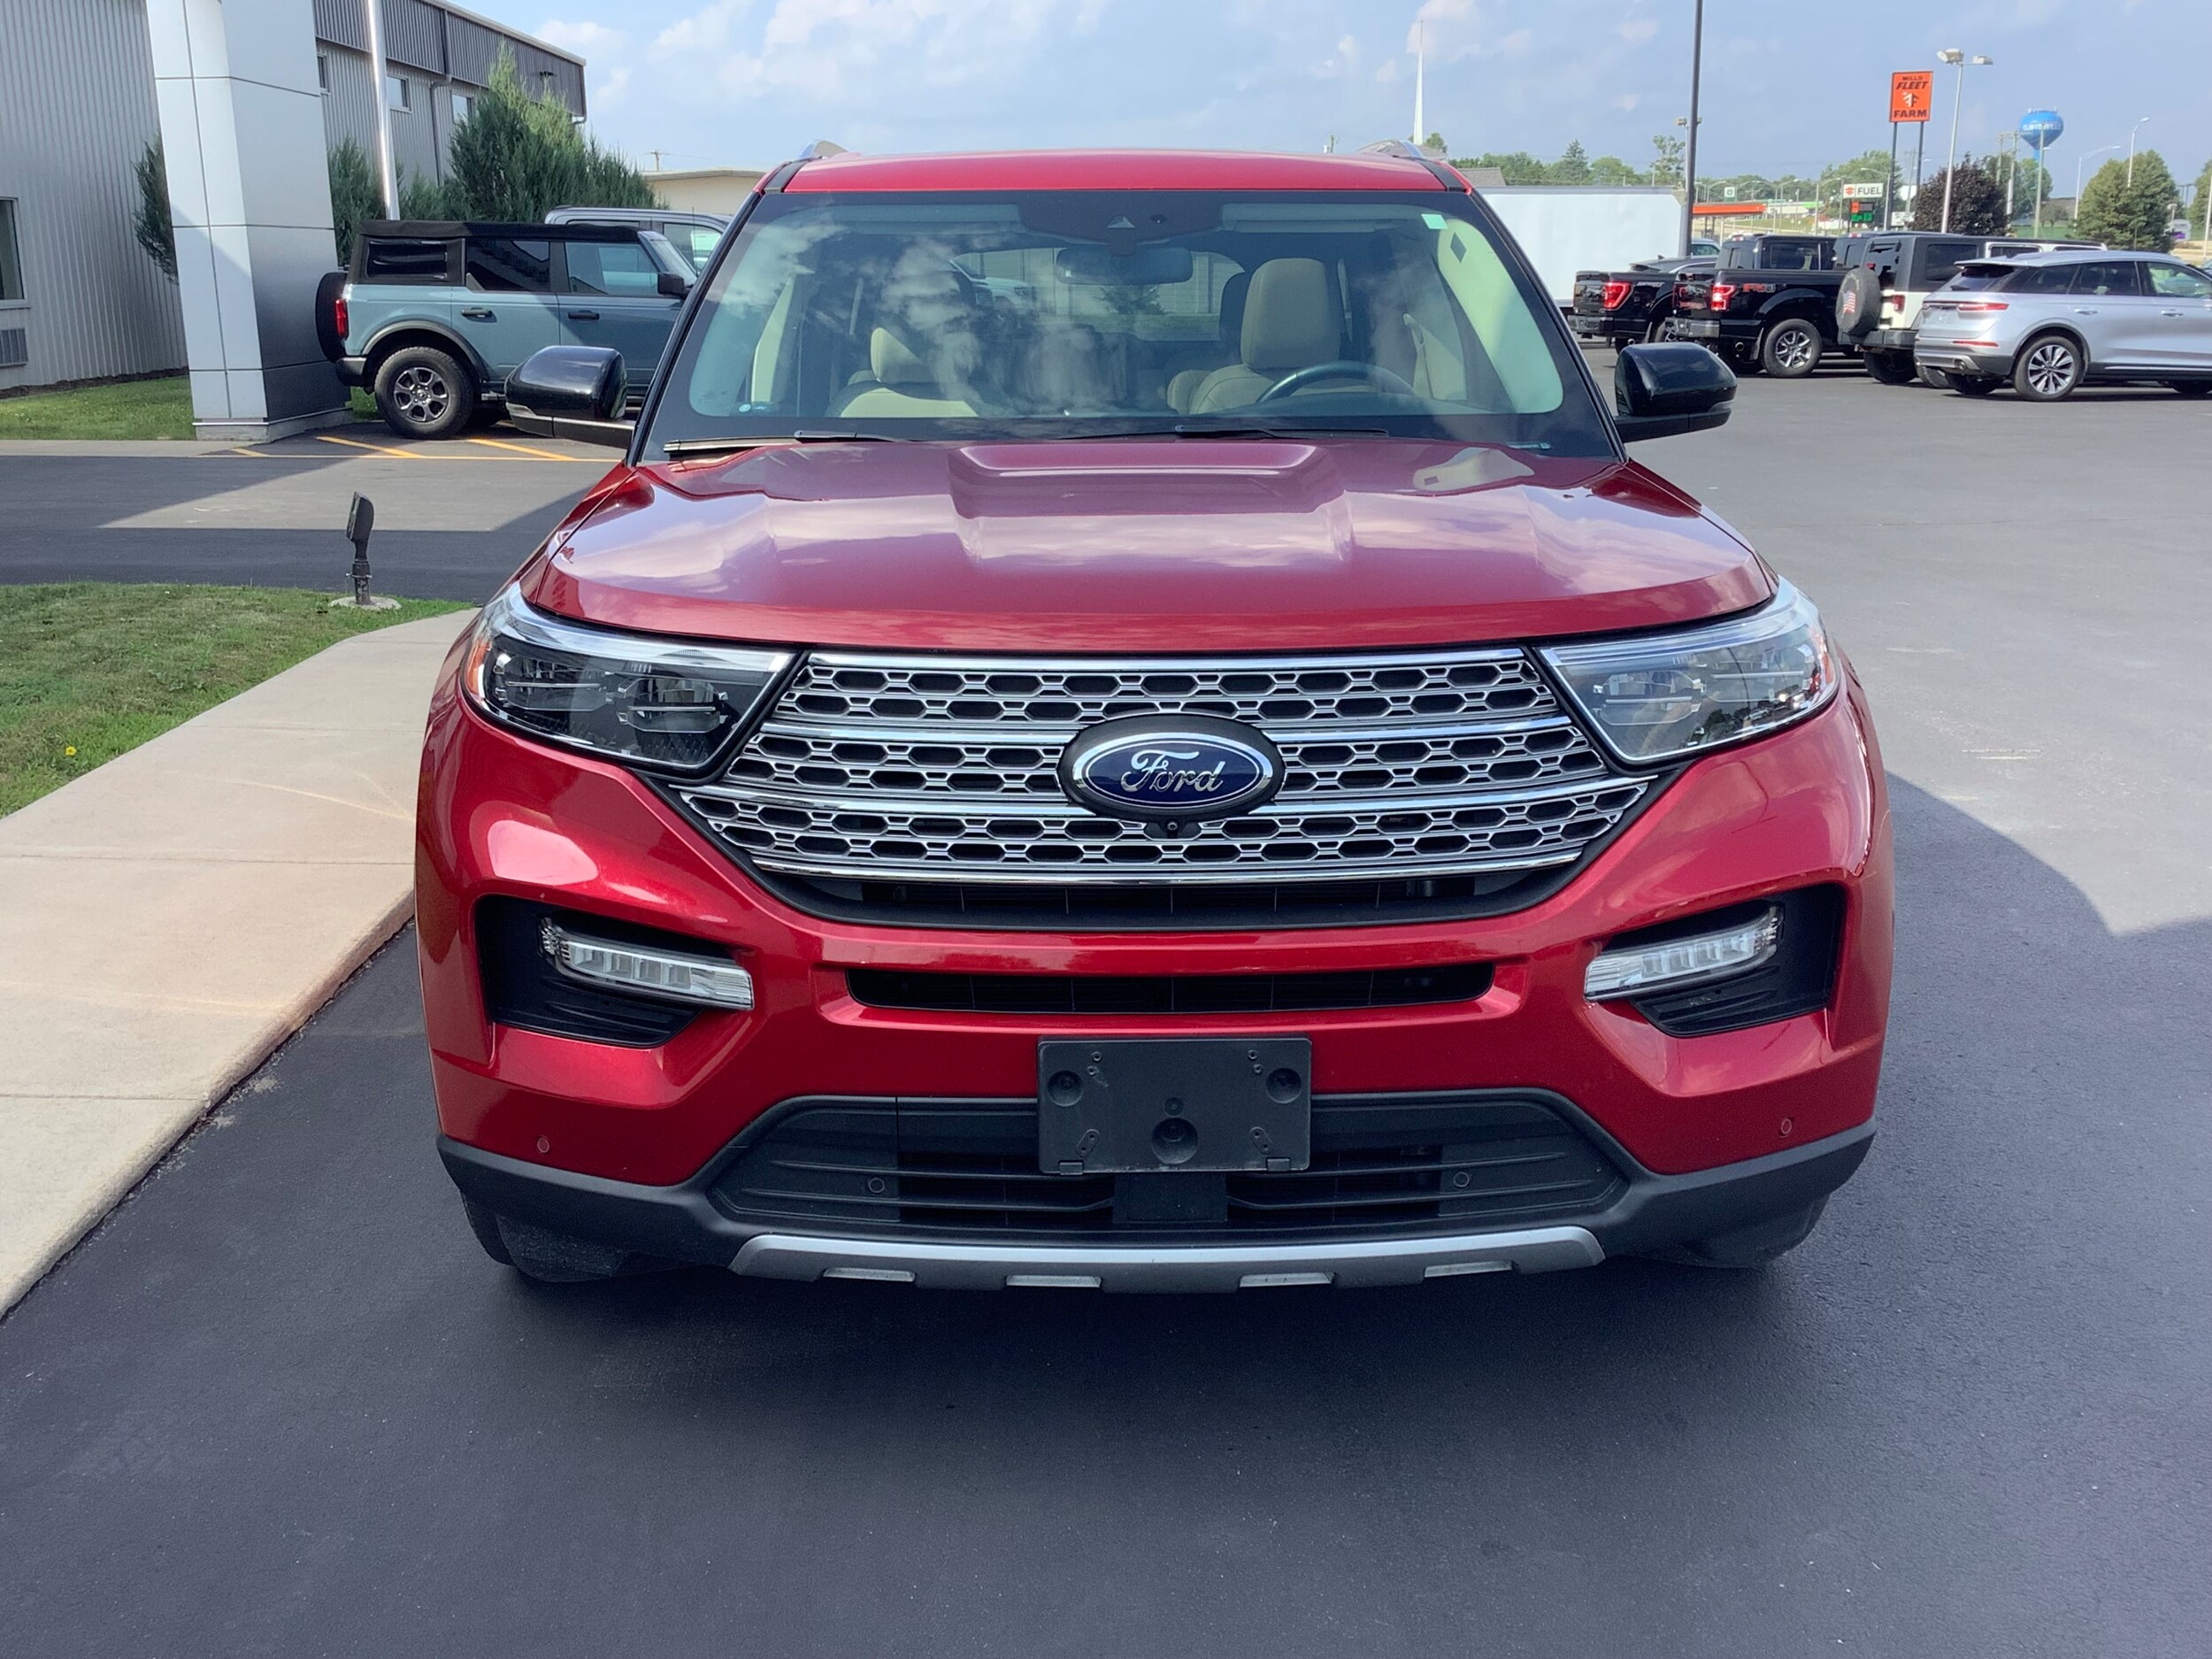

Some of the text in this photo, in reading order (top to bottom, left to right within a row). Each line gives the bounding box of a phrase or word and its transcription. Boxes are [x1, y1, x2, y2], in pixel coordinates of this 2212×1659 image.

[1896, 81, 1929, 90] FLEET
[1893, 109, 1927, 118] FARM
[1858, 187, 1882, 196] FUEL
[1120, 749, 1226, 793] Ford
